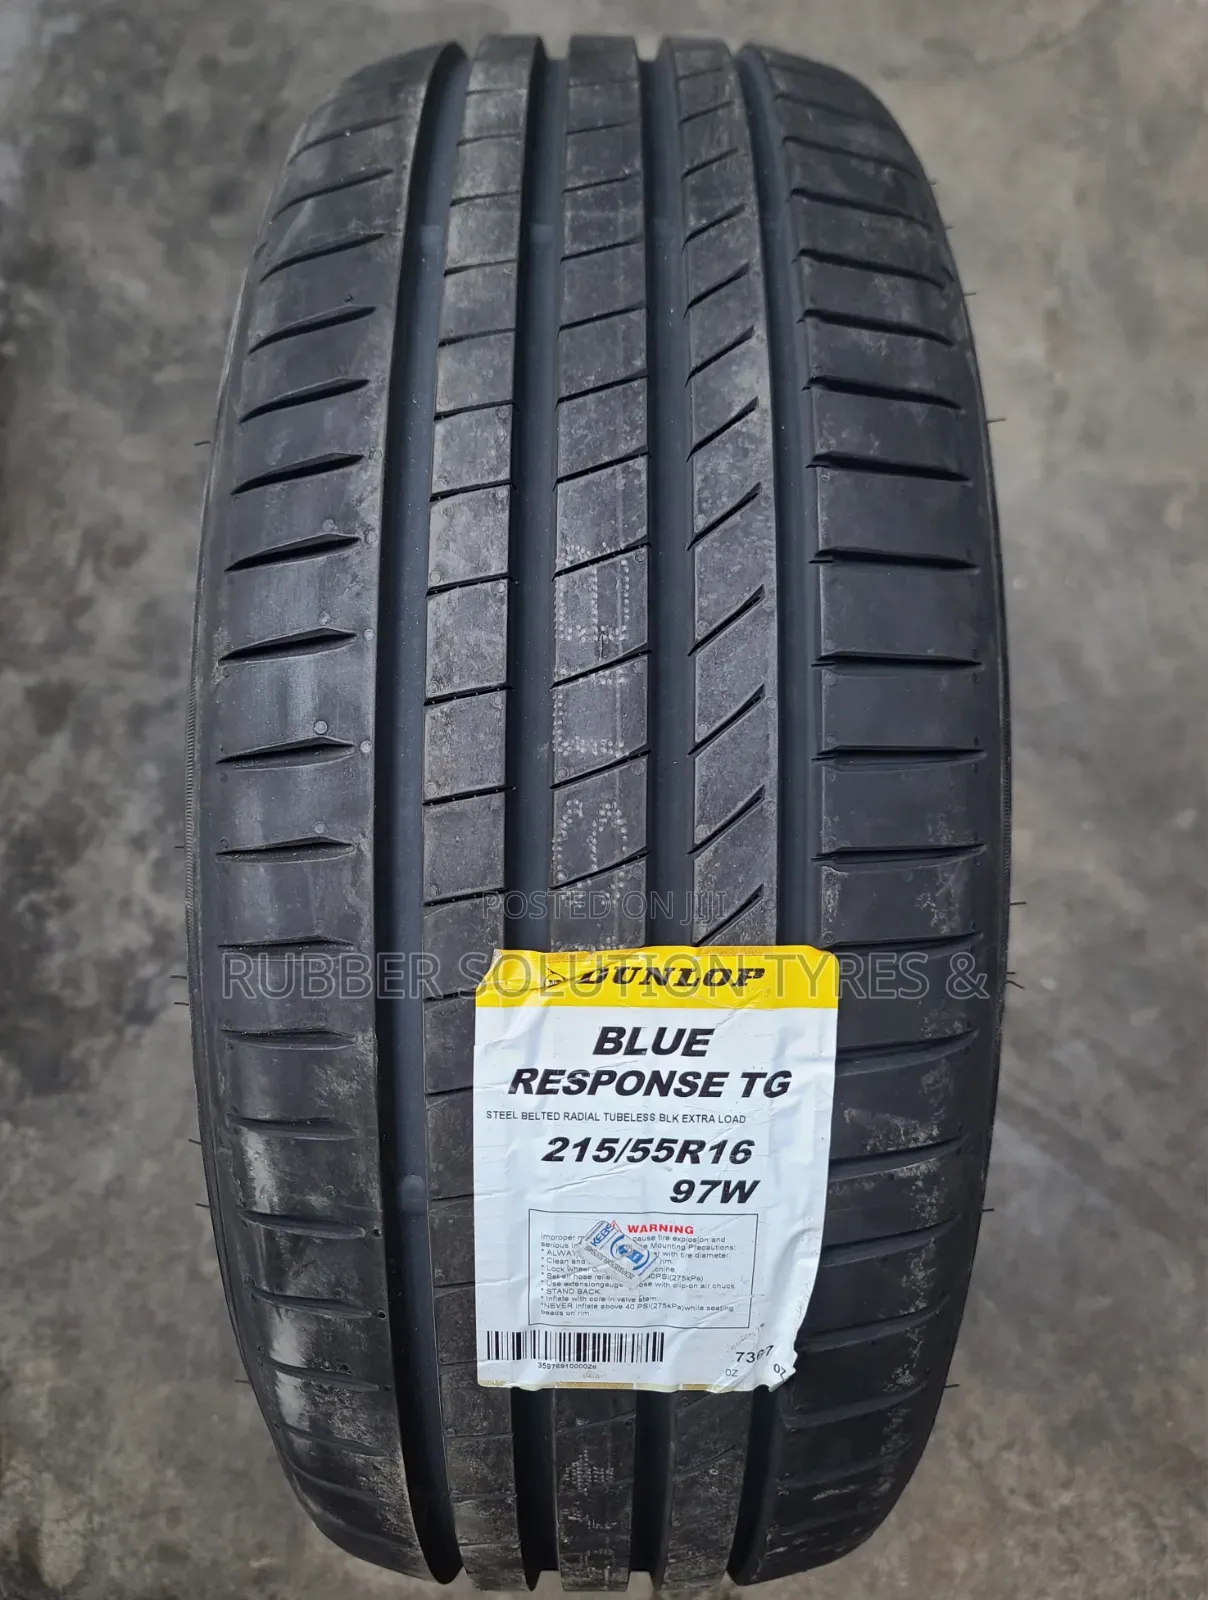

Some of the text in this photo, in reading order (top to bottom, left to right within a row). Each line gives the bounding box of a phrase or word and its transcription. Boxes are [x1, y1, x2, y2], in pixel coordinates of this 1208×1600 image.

[575, 966, 766, 987] DUNLOP
[592, 1026, 716, 1057] BLUE
[507, 1068, 792, 1098] RESPONSE TG
[486, 1110, 747, 1124] STEEL BELTED RADIAL TUBELESS BLK EXTRA LOAD
[541, 1136, 756, 1165] 215/55R16
[669, 1179, 761, 1204] 97W
[627, 1224, 695, 1235] WARNING
[541, 1233, 576, 1242] Improper
[658, 1233, 671, 1242] tire
[672, 1235, 708, 1244] explosion
[651, 1242, 686, 1251] Mounting
[546, 1249, 580, 1257] ALWAY
[662, 1250, 678, 1258] with
[680, 1251, 692, 1259] tire
[546, 1256, 569, 1265] Clean
[546, 1264, 565, 1273] Lock
[567, 1264, 590, 1273] wheel
[594, 1273, 613, 1281] relie
[647, 1273, 704, 1283] 0PSI(275kPa)
[546, 1280, 562, 1288] Use
[546, 1288, 575, 1296] STAND
[616, 1296, 637, 1304] valve
[600, 1303, 624, 1311] above
[706, 1304, 735, 1313] seating
[540, 1309, 565, 1318] beads
